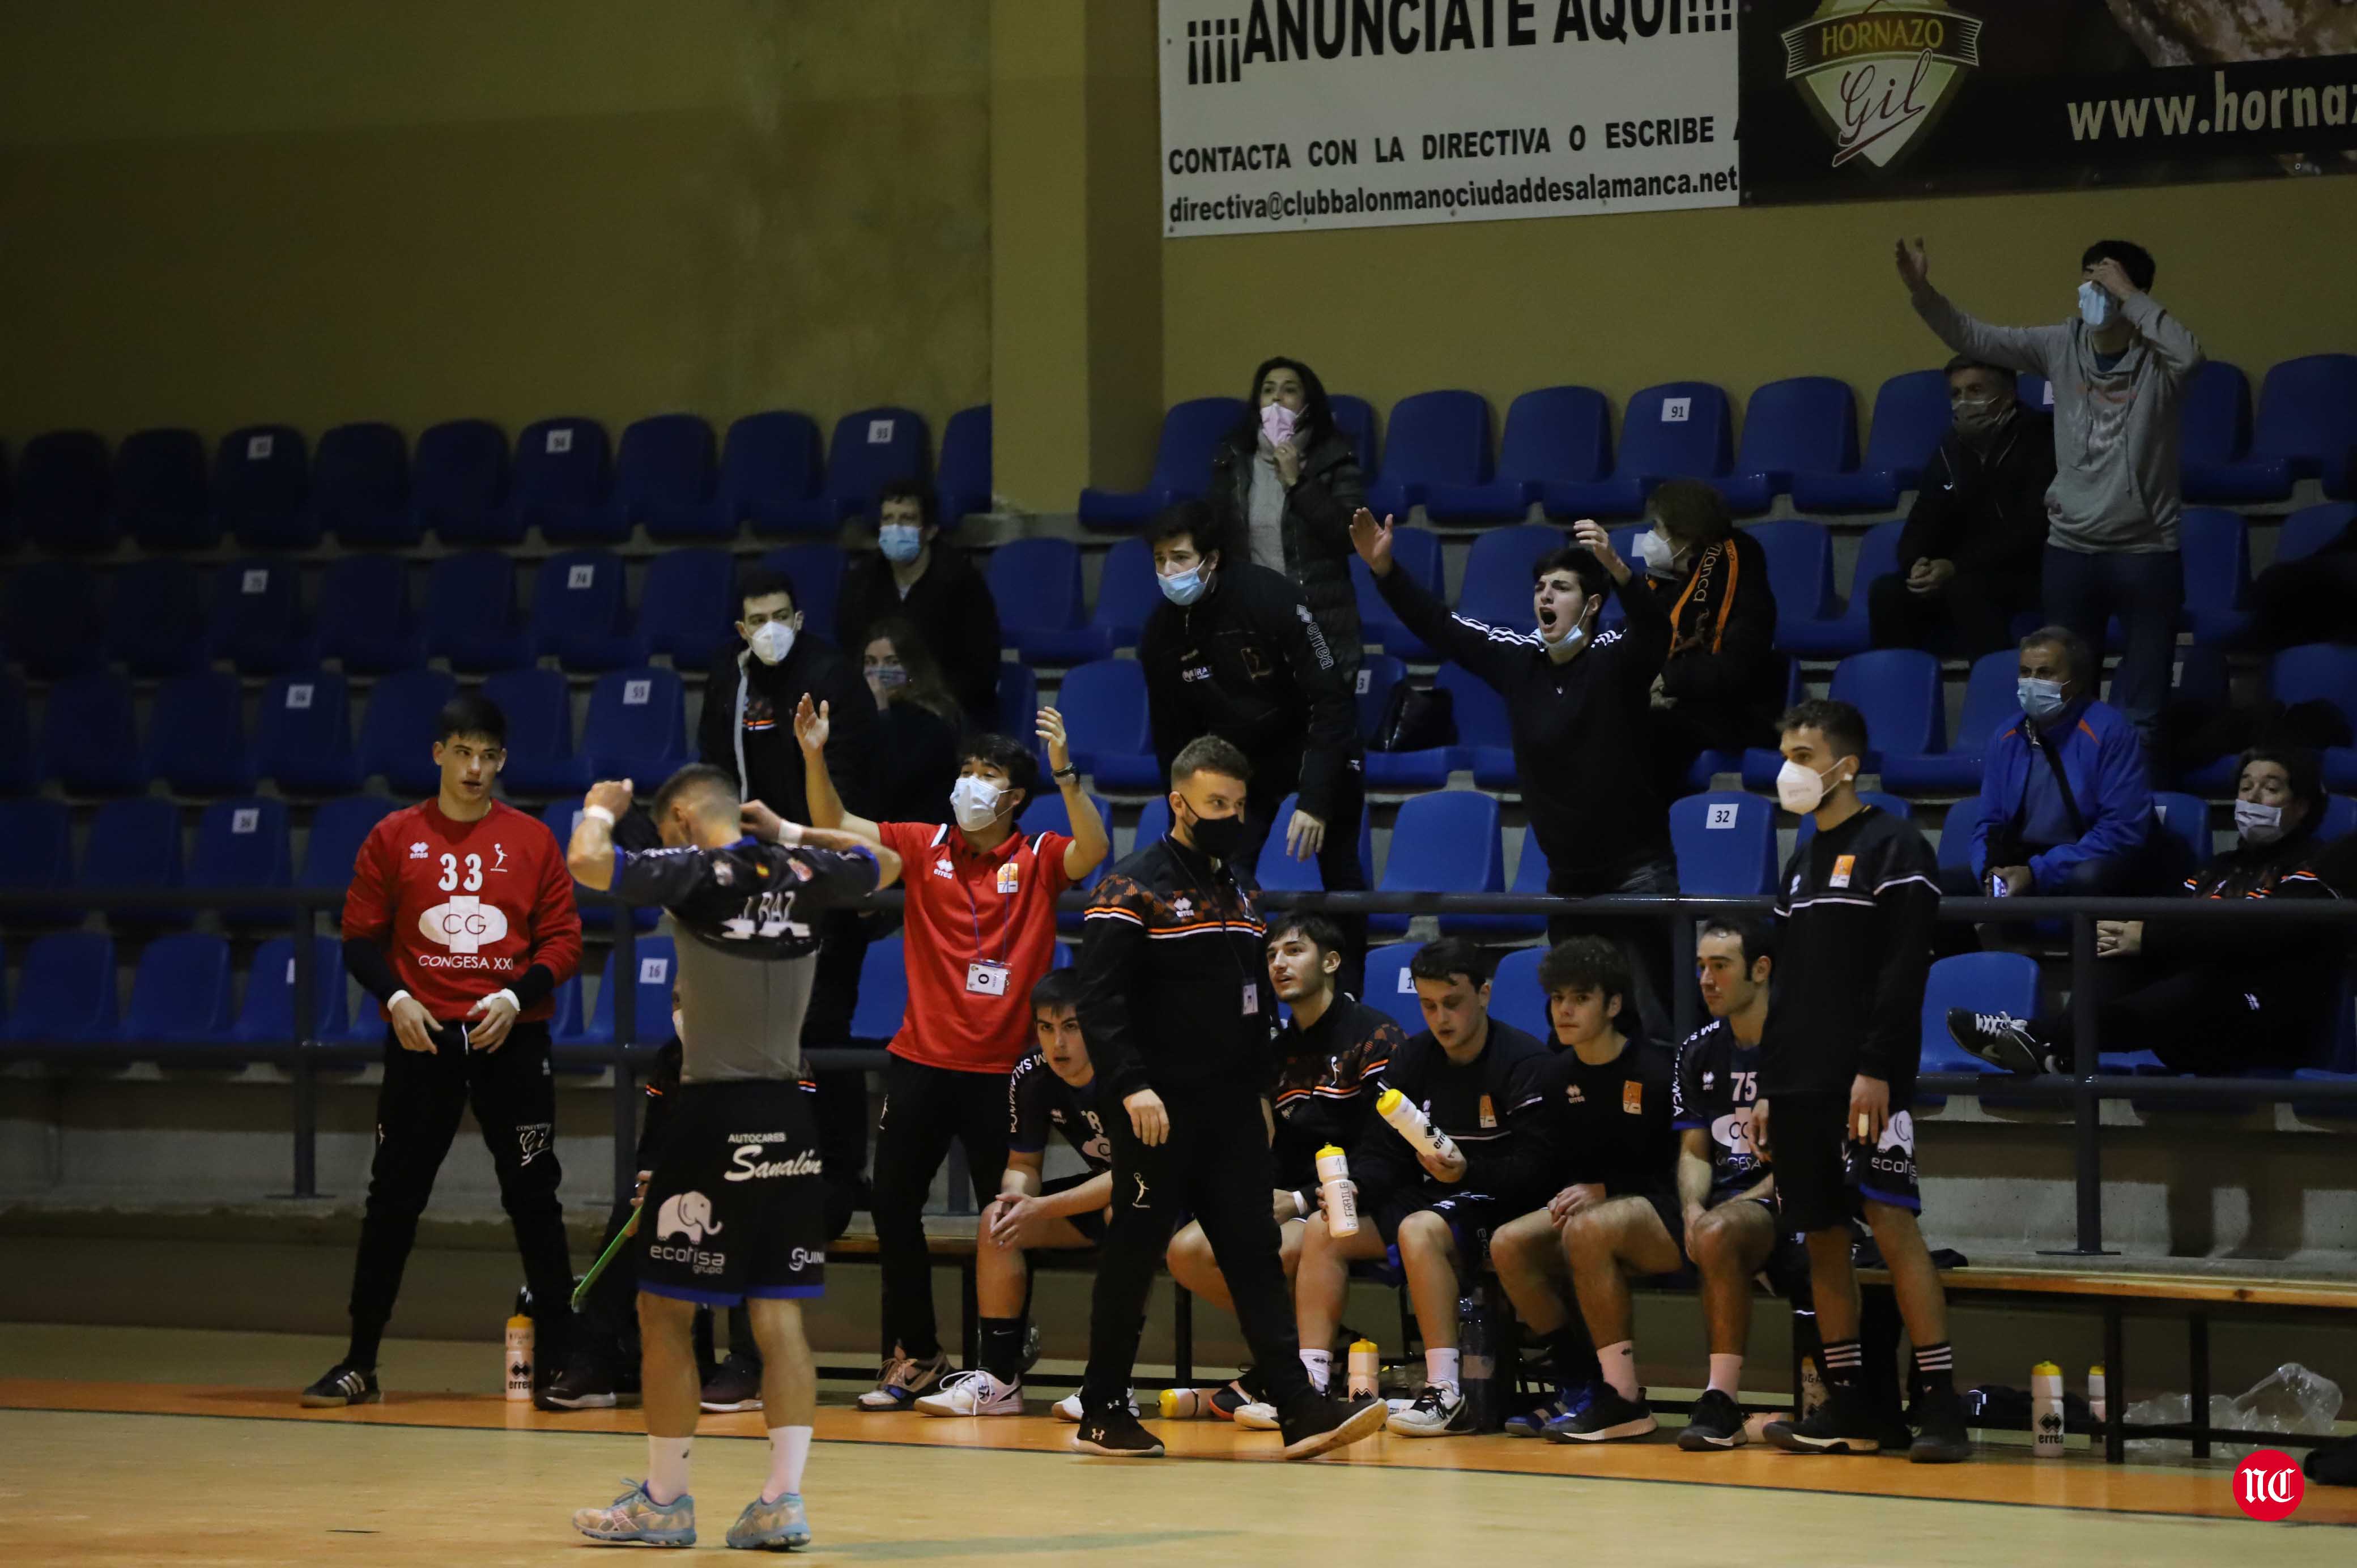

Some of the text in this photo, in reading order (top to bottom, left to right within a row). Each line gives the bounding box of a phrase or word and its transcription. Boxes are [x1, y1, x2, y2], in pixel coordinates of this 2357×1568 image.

[1822, 18, 1944, 56] HORNAZO
[1833, 49, 1925, 162] Gil
[2067, 71, 2357, 142] www.horna
[1169, 143, 1291, 174] CONTACTA
[1308, 139, 1358, 167] CON
[1375, 137, 1404, 164] LA
[1423, 127, 1551, 160] DIRECTIVA
[1569, 125, 1586, 151] O
[1606, 116, 1714, 148] ESCRIBE
[1170, 168, 1738, 223] directiva@clubbalonmanociudaddesalamanca.net
[1671, 406, 1684, 418] 91
[1305, 622, 1334, 670] errea
[1714, 810, 1729, 823] 32
[438, 853, 482, 892] 33
[443, 914, 486, 934] CG
[419, 955, 490, 970] CONGESA
[1730, 1072, 1759, 1101] 75
[727, 1132, 787, 1144] AUTOCARES
[692, 1264, 725, 1275] grupo
[2038, 1434, 2064, 1444] errea
